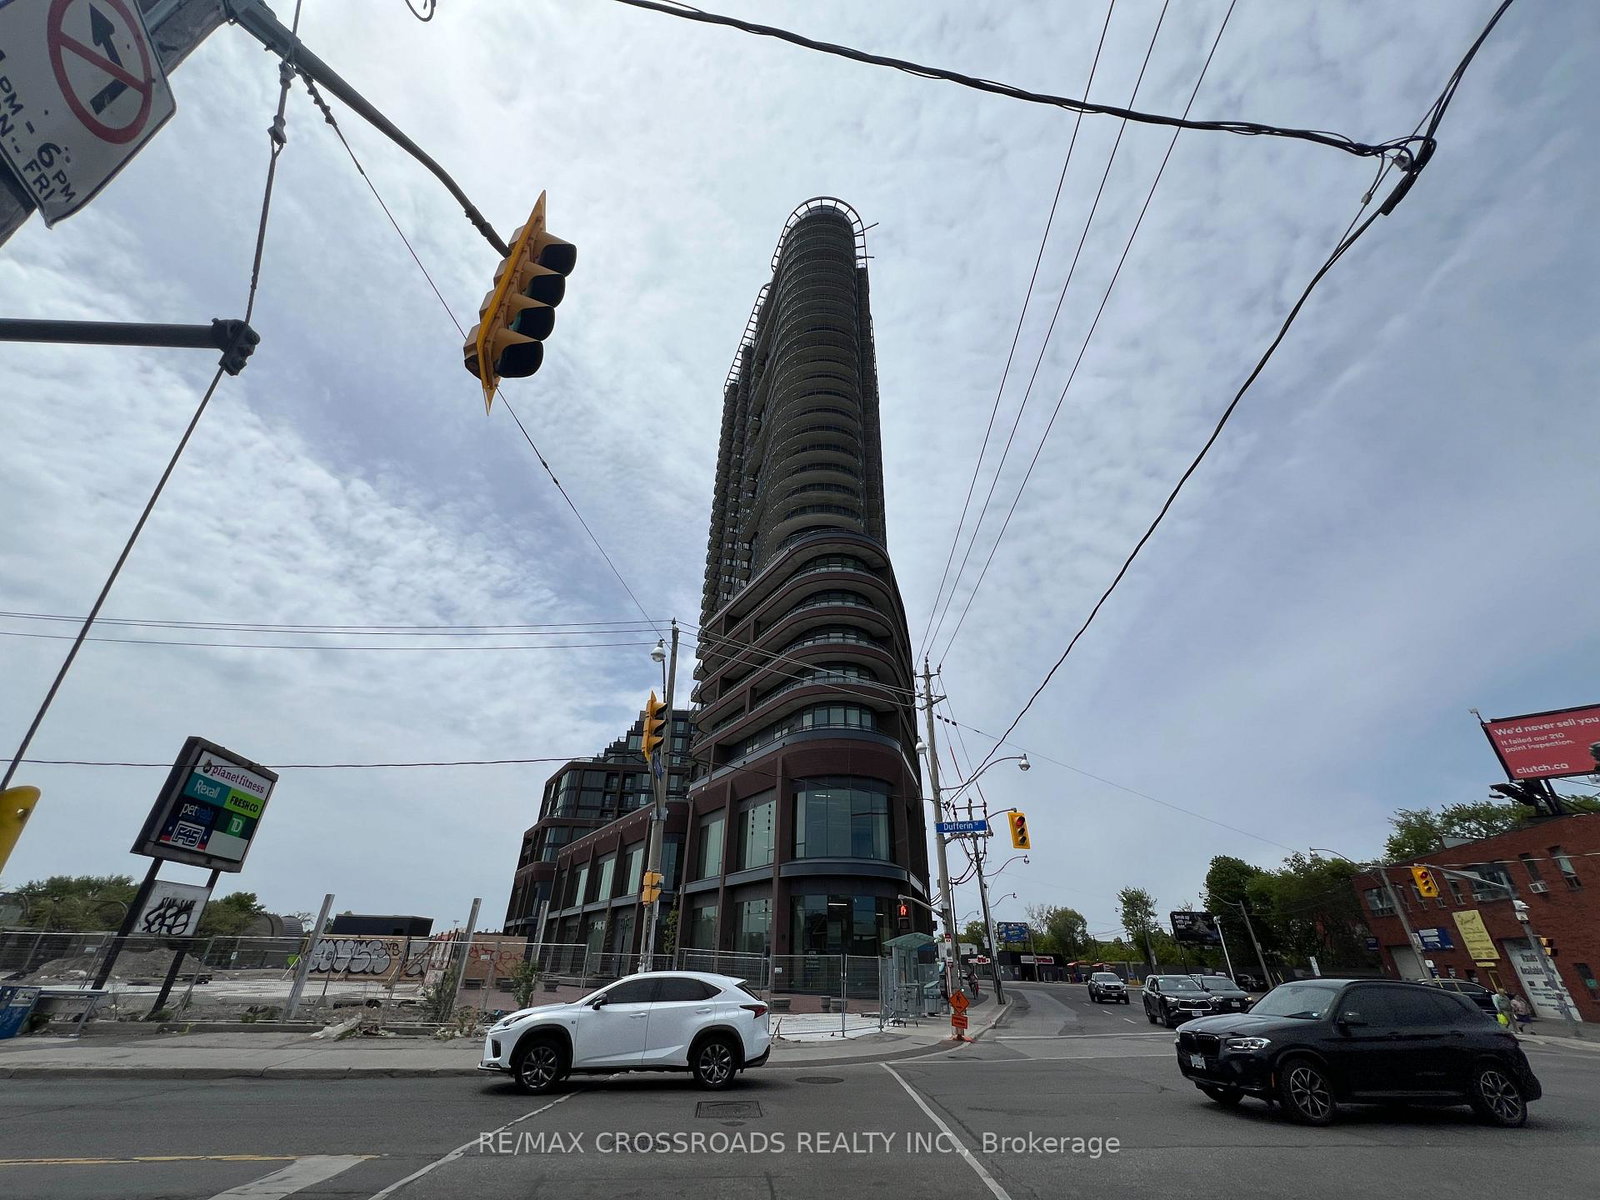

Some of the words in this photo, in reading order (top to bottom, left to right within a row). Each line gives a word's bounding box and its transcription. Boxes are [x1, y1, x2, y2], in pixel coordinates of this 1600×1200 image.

[37, 142, 62, 168] 6
[52, 169, 76, 203] PM
[1494, 726, 1523, 736] We'd
[1524, 722, 1555, 732] never
[1556, 718, 1577, 728] sell
[1577, 715, 1599, 726] you
[1509, 736, 1532, 745] failed
[1504, 745, 1527, 753] point
[1516, 762, 1569, 774] clutch.ca
[194, 779, 220, 799] Rexall
[943, 821, 974, 831] Dufferin
